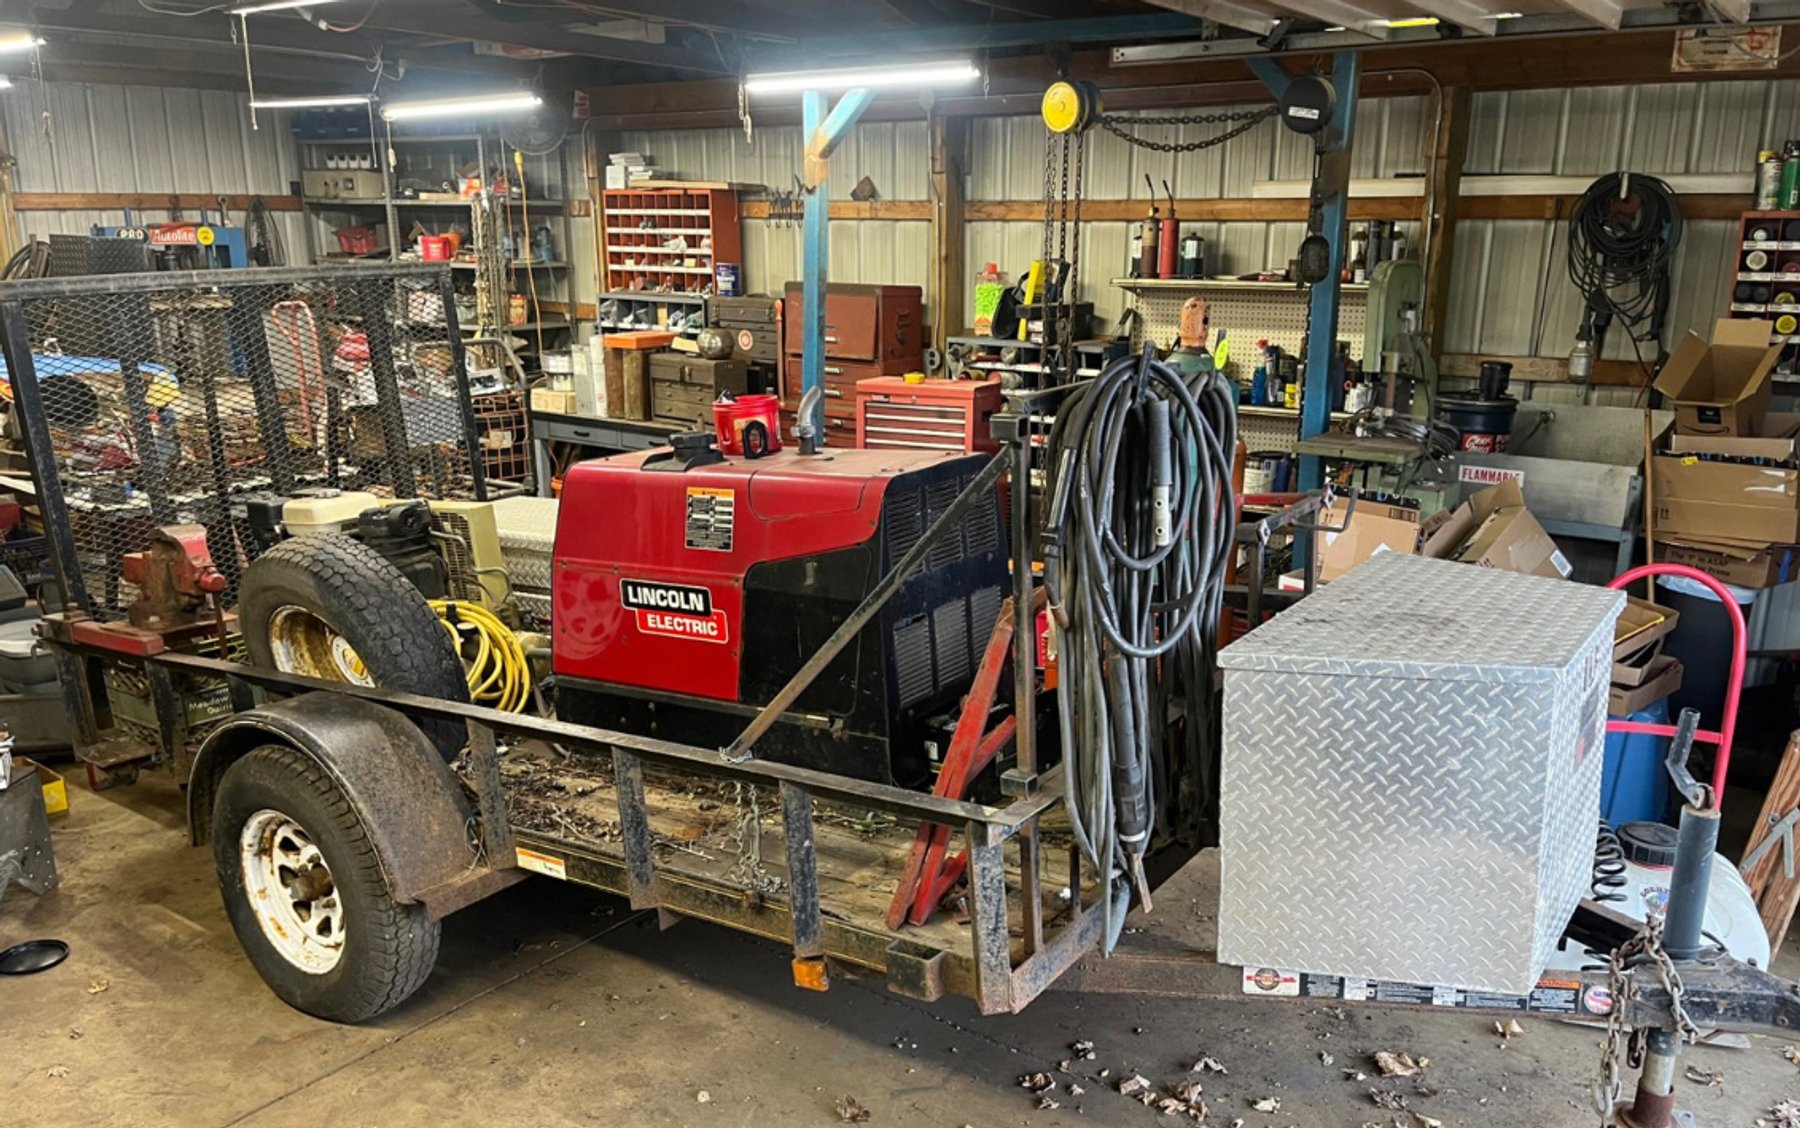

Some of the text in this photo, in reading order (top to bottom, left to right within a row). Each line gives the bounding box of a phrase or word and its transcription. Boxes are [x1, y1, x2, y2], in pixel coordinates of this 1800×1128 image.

[119, 228, 196, 242] PRO Autolite
[627, 585, 705, 612] LINCOLN
[647, 614, 718, 636] ELECTRIC
